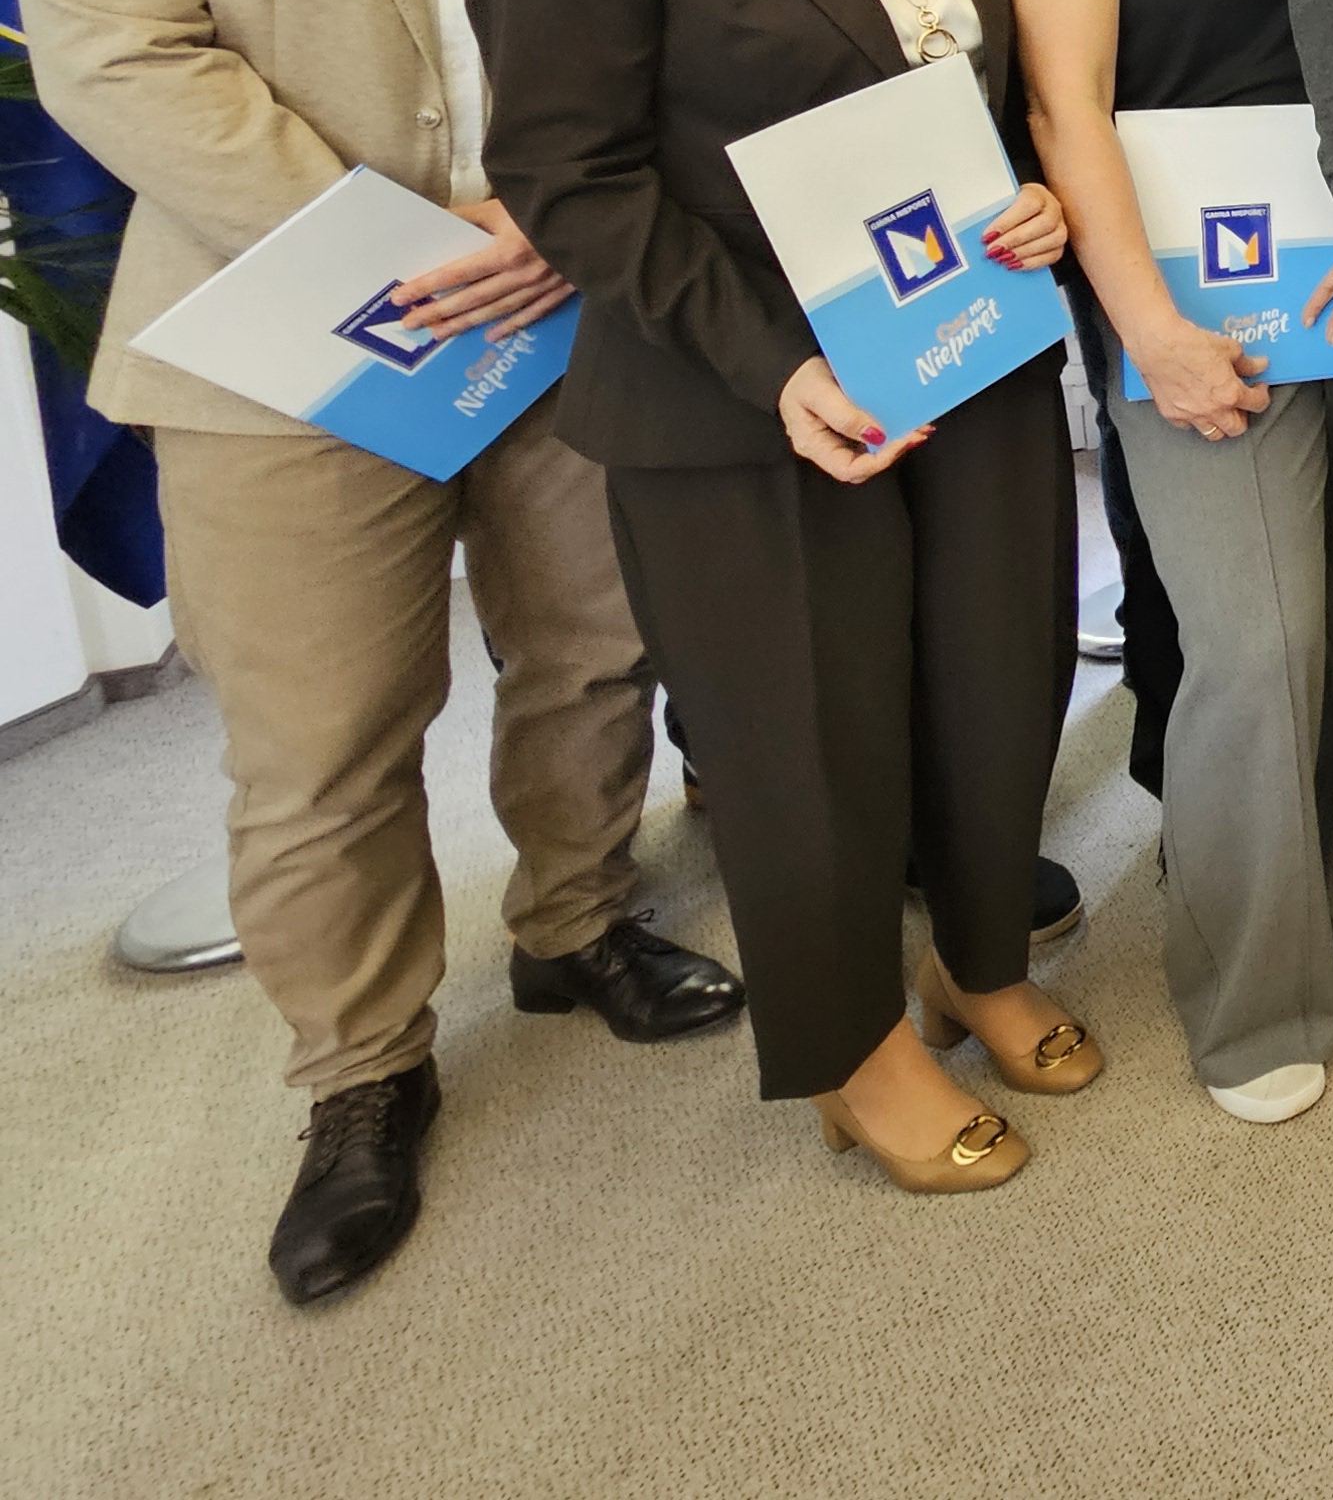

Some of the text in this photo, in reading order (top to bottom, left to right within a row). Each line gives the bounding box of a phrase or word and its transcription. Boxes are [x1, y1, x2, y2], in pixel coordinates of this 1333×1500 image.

[915, 298, 1002, 386] Nieporęt
[1217, 313, 1290, 343] poręt
[453, 330, 537, 418] Nieporęt
